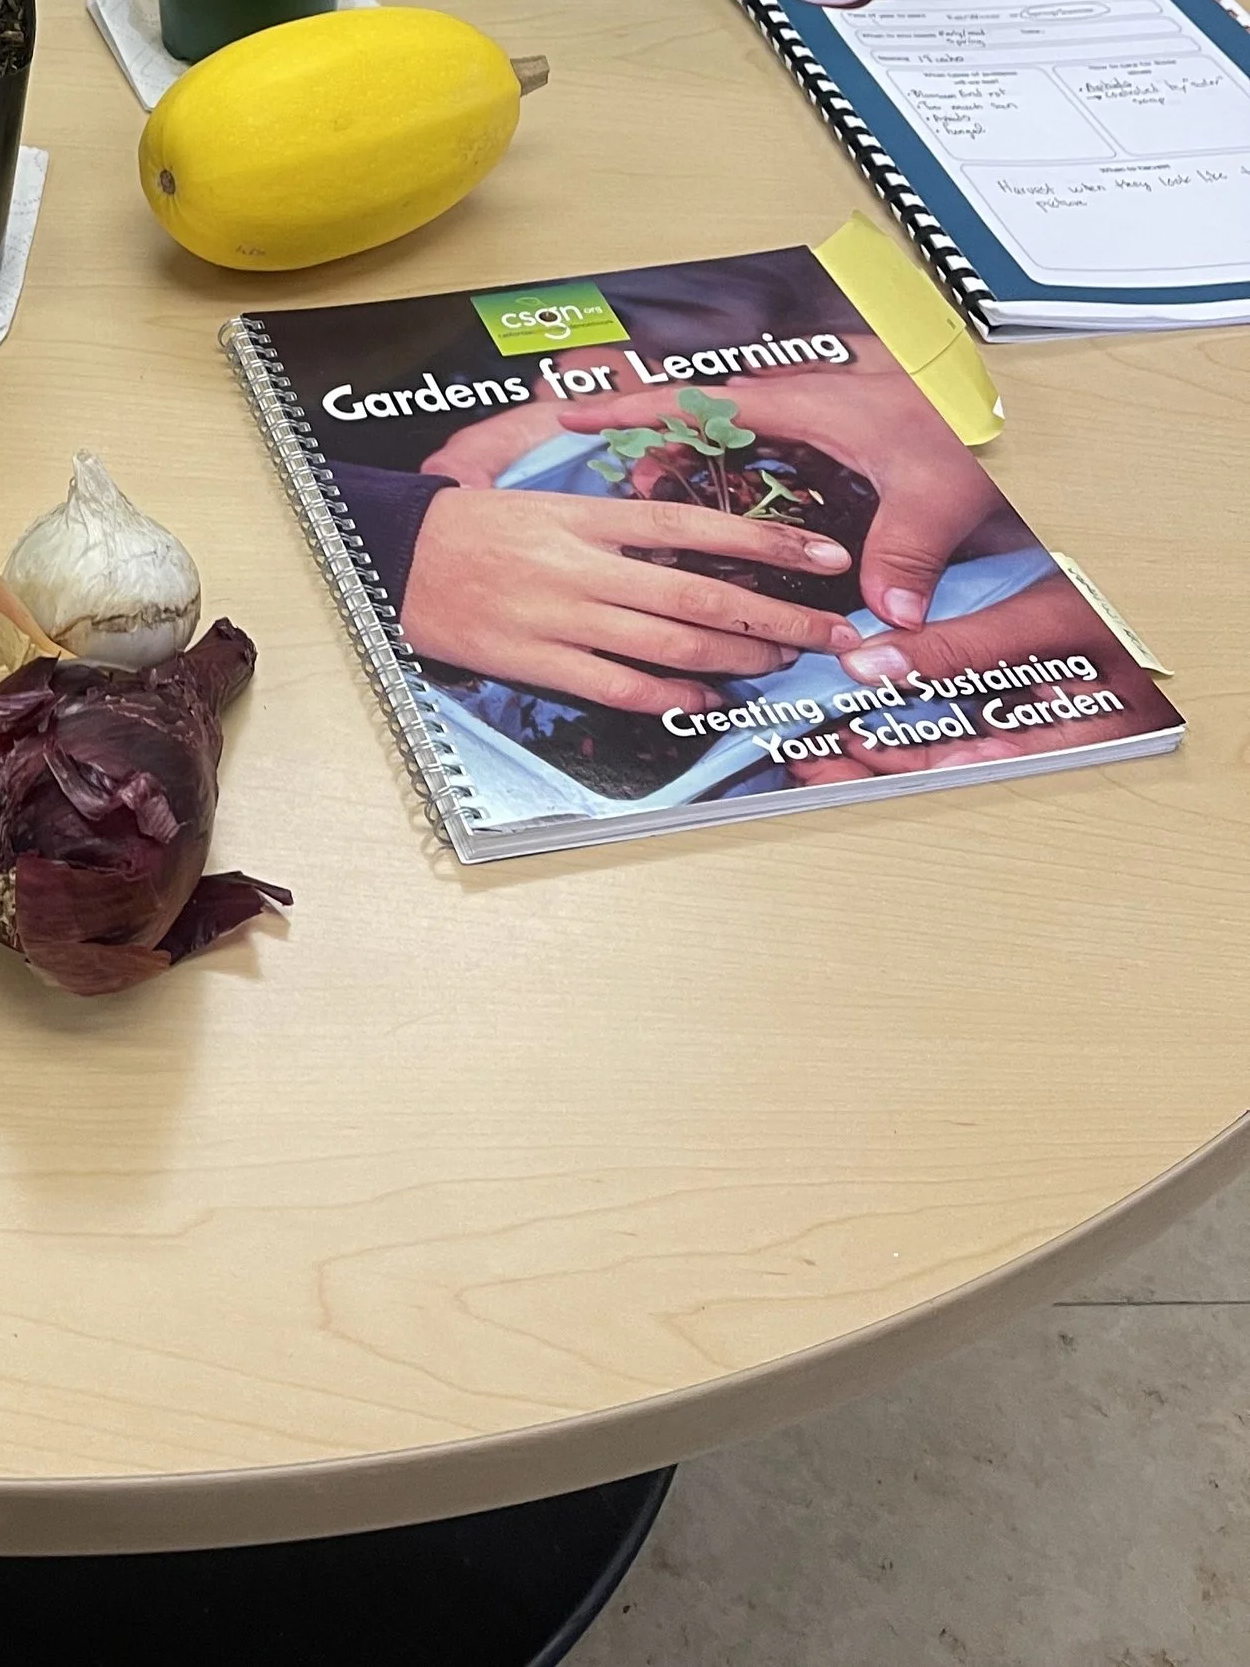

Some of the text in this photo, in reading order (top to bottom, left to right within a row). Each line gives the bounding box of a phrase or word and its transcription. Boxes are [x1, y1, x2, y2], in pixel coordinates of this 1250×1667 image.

[998, 180, 1055, 195] Harvest
[1068, 182, 1106, 194] when
[1115, 179, 1151, 193] they
[1158, 176, 1191, 187] look
[1197, 169, 1227, 183] like
[501, 305, 583, 340] csgn
[322, 332, 850, 422] Gardens for Learning
[661, 653, 1098, 738] Creating and Sustaining
[753, 687, 1124, 765] Your School Garden
